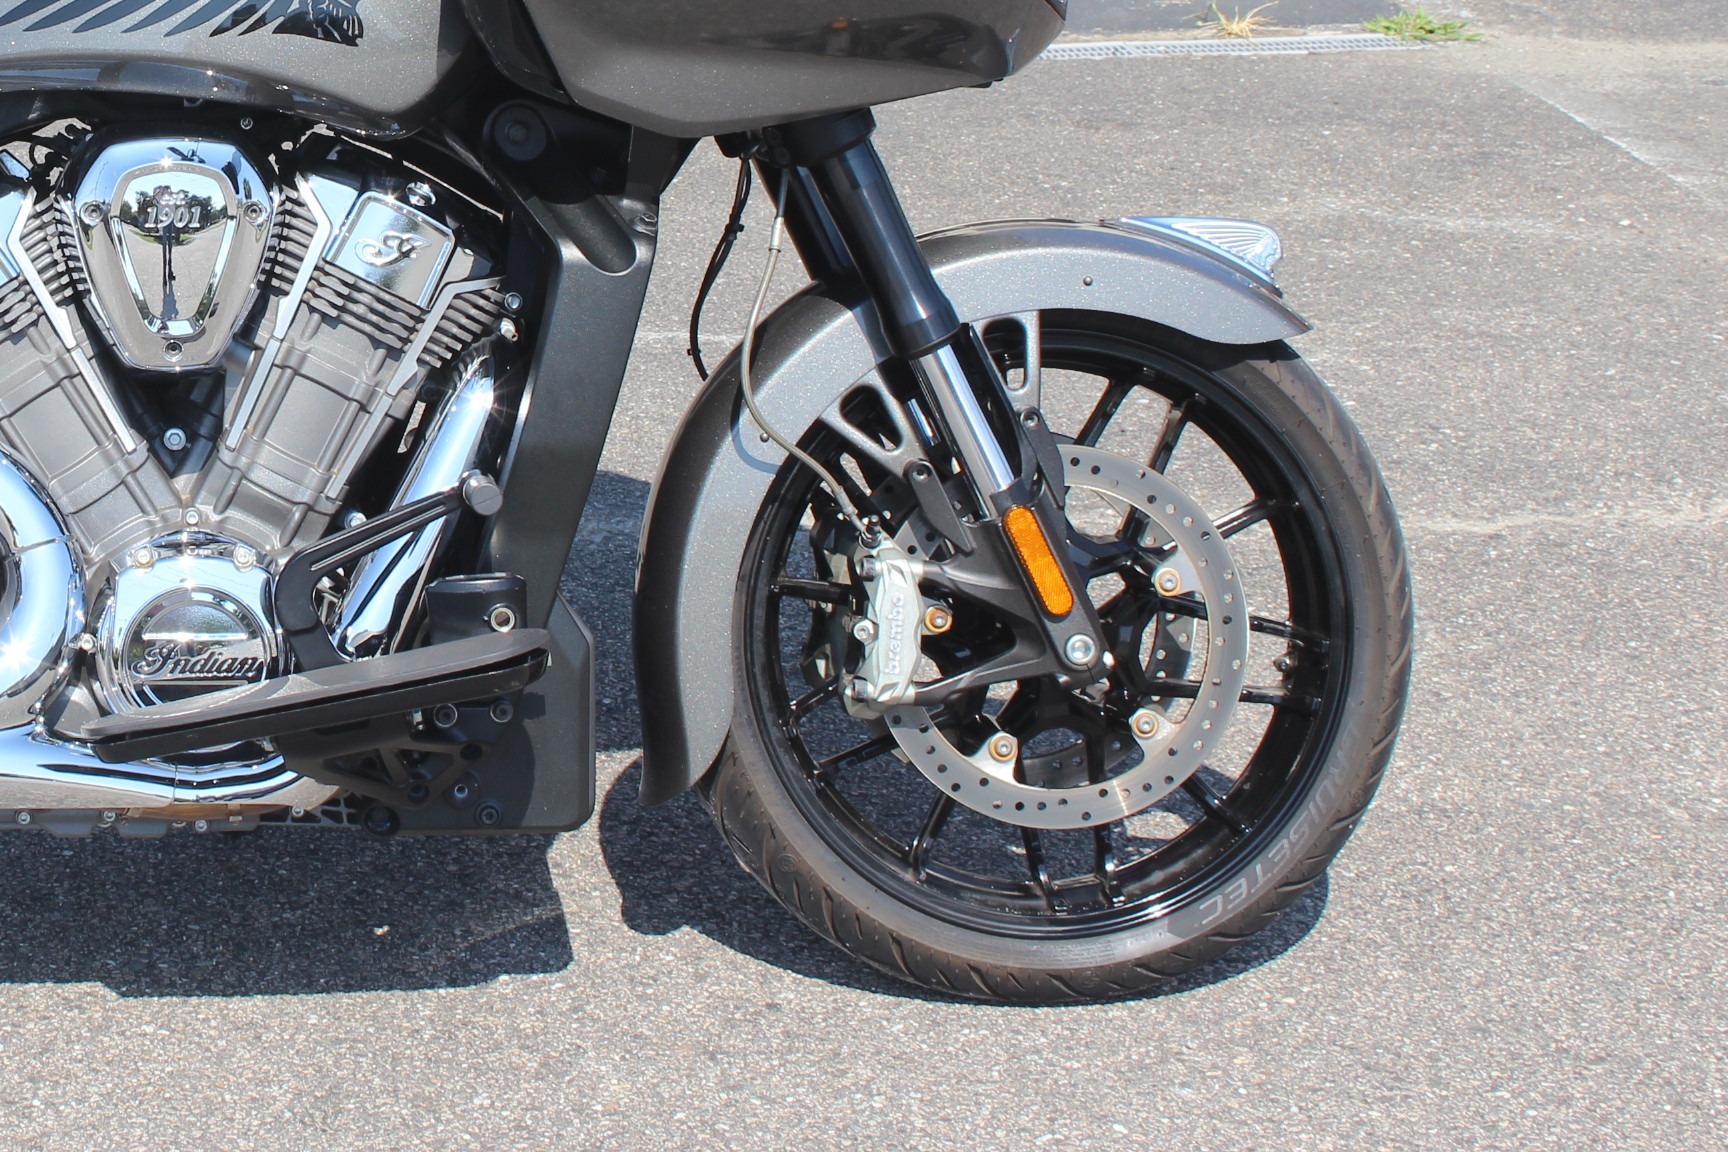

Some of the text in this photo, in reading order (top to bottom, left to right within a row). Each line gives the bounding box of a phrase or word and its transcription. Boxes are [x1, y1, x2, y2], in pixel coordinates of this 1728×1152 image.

[144, 205, 201, 229] 1901
[884, 592, 907, 676] brembo
[132, 641, 263, 679] Indian
